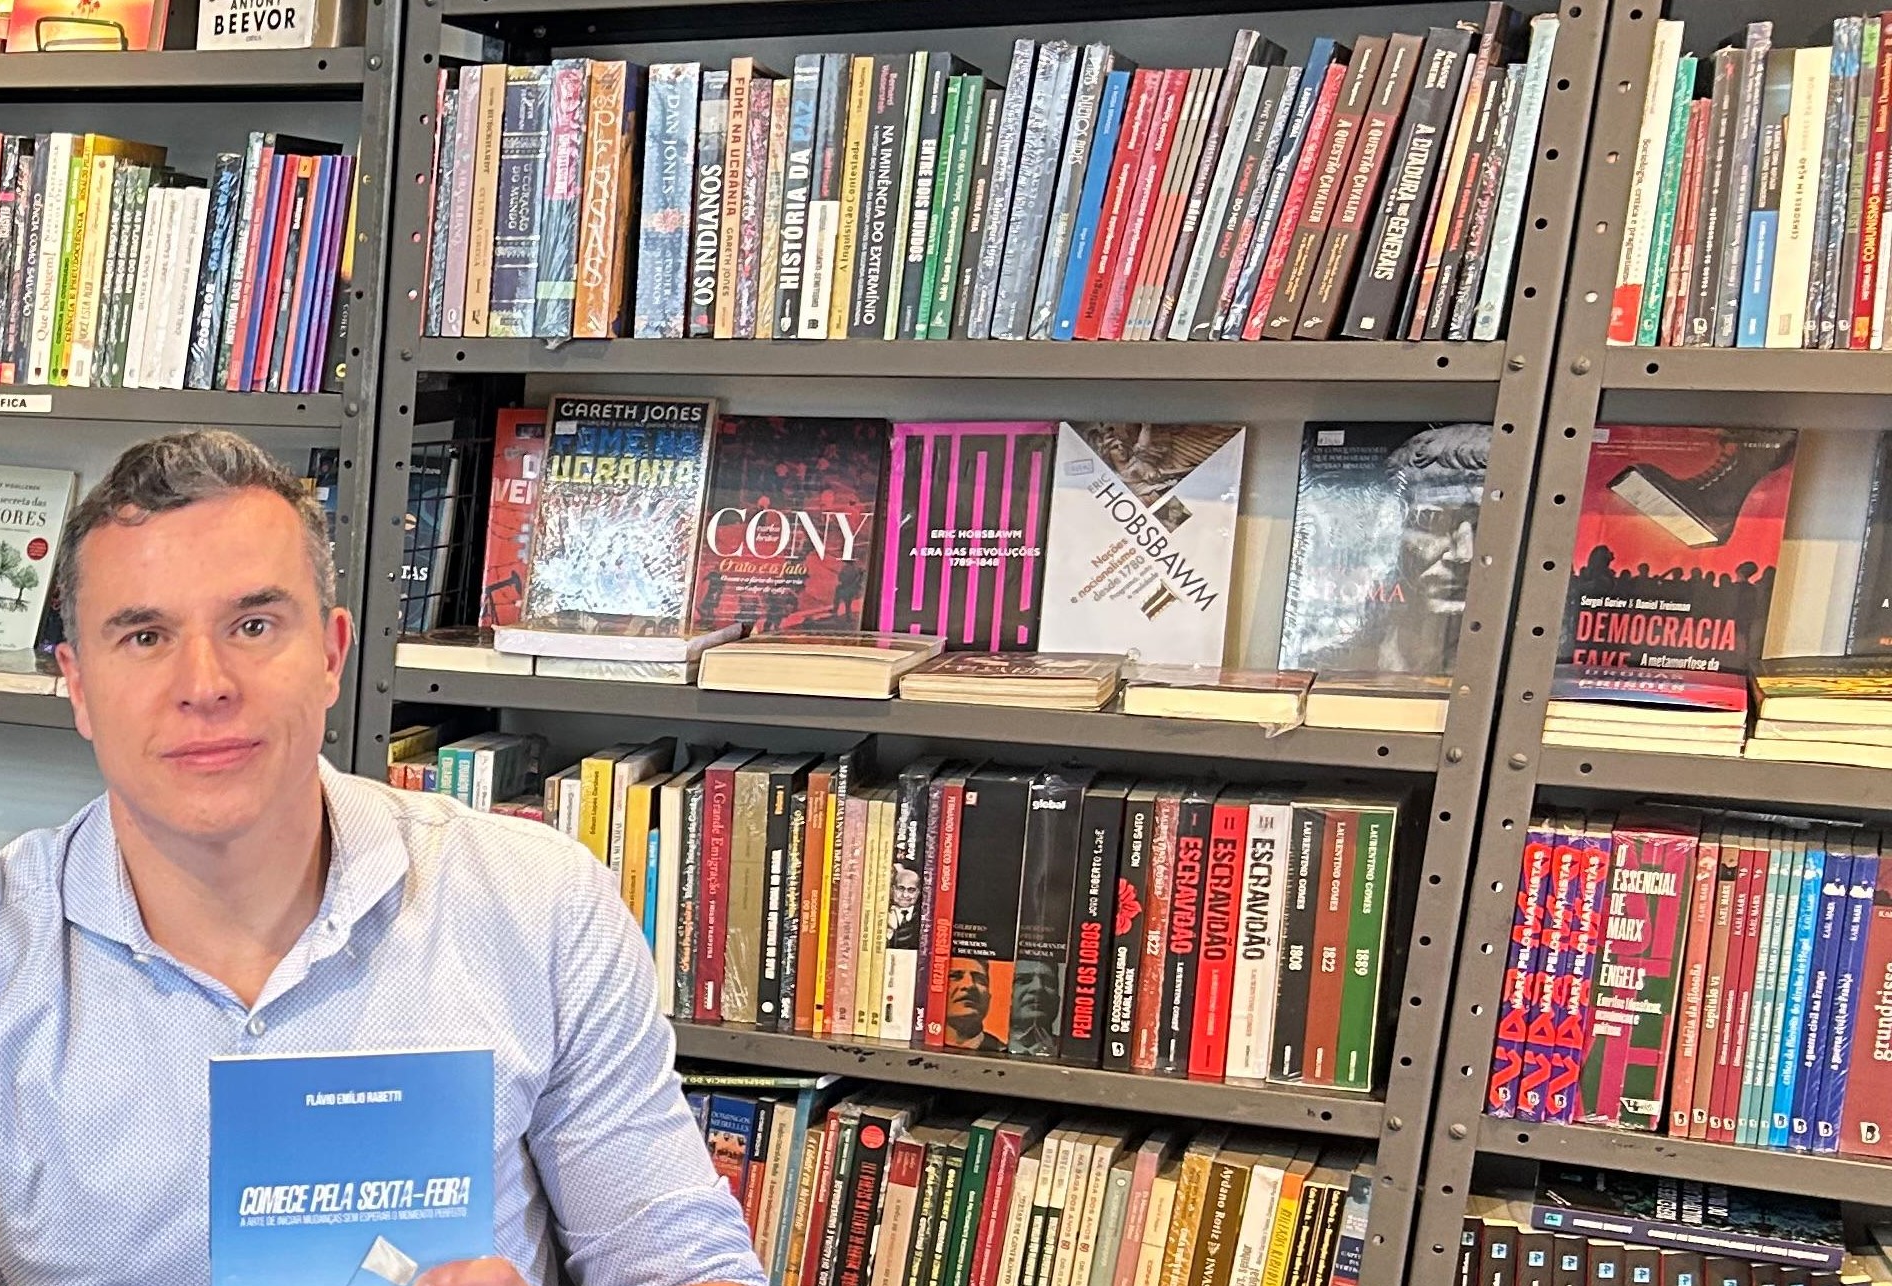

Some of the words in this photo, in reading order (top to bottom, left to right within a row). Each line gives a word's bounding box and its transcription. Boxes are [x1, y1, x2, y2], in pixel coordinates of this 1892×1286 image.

[213, 12, 297, 35] BEEVOR
[794, 100, 814, 142] PAZ
[881, 125, 895, 144] NA
[1418, 123, 1436, 135] A
[788, 148, 812, 179] DA
[920, 139, 936, 176] ENTRE
[1394, 138, 1428, 201] DITADURA
[873, 148, 893, 218] IMINÊNCIA
[914, 179, 930, 207] DOIS
[30, 193, 42, 231] CIÊNCIA
[695, 164, 723, 271] INDIANOS
[779, 188, 807, 289] HISTÓRIA
[870, 221, 884, 242] DO
[908, 211, 927, 262] MUNDOS
[1865, 195, 1882, 262] COMUNISMO
[27, 233, 38, 264] COMO
[1374, 214, 1409, 281] GENERAIS
[22, 266, 35, 316] SALVAÇÃO
[38, 251, 57, 311] bobagem!
[693, 276, 716, 306] OS
[863, 246, 883, 324] EXTERMÍNIO
[36, 315, 50, 341] Que
[560, 402, 637, 422] GARETH
[642, 405, 702, 422] JONES
[549, 453, 698, 488] UCRÂNIA
[0, 495, 28, 506] secreta
[30, 497, 47, 508] das
[706, 507, 873, 562] CONY
[931, 529, 956, 539] ERIC
[958, 529, 1022, 539] HOBSBAWM
[1097, 481, 1219, 613] HOBSBAWM
[909, 546, 918, 557] A
[920, 546, 943, 557] ERA
[946, 546, 968, 557] DAS
[970, 544, 1041, 559] REVOLUÇÕES
[1090, 537, 1130, 568] Nações
[1576, 611, 1736, 651] DEMOCRACIA
[1640, 653, 1648, 668] A
[1648, 655, 1708, 671] metamorfose
[1709, 658, 1719, 671] da
[1031, 799, 1067, 810] global
[1223, 817, 1235, 830] II
[1299, 821, 1313, 877] LAURENTINO
[1331, 822, 1346, 878] LAURENTINO
[1364, 824, 1380, 881] LAURENTINO
[1616, 843, 1627, 868] O
[1296, 879, 1308, 910] GOMES
[1328, 880, 1341, 912] GOMES
[1361, 882, 1374, 914] GOMES
[1522, 851, 1544, 926] MARXISTAS
[1551, 853, 1574, 929] MARXISTAS
[1578, 855, 1600, 931] MARXISTAS
[1612, 868, 1677, 897] ESSENCIAL
[1202, 837, 1237, 961] ESCRAVIDÃO
[1242, 837, 1276, 961] ESCRAVIDÃO
[1610, 894, 1628, 917] DE
[1079, 922, 1102, 964] LOBOS
[1146, 929, 1161, 956] 1822
[1607, 916, 1645, 943] MARX
[1288, 944, 1304, 971] 1808
[1321, 946, 1337, 973] 1822
[1354, 948, 1370, 976] 1889
[1517, 929, 1533, 969] PELOS
[1545, 932, 1561, 972] PELOS
[1573, 933, 1589, 975] PELOS
[1603, 941, 1613, 964] E
[1077, 966, 1098, 984] OS
[1111, 946, 1128, 1022] ECOSSOCIALISMO
[1124, 968, 1136, 993] MARX
[1511, 971, 1528, 1009] MARX
[1599, 965, 1646, 992] ENGELS
[1122, 995, 1133, 1018] KARL
[1540, 975, 1556, 1013] MARX
[1567, 977, 1583, 1016] MARX
[1072, 996, 1095, 1039] PEDRO
[1110, 1024, 1121, 1032] O
[1121, 1020, 1131, 1033] DE
[306, 1091, 335, 1107] FLÁVIO
[336, 1091, 365, 1106] EMÍLIO
[367, 1090, 402, 1104] RABETTI
[239, 1185, 308, 1216] COMECE
[311, 1182, 353, 1214] PELA
[356, 1176, 471, 1211] SEXTA-FEIRA
[1215, 1167, 1234, 1208] Aydano
[1210, 1211, 1227, 1240] Roriz
